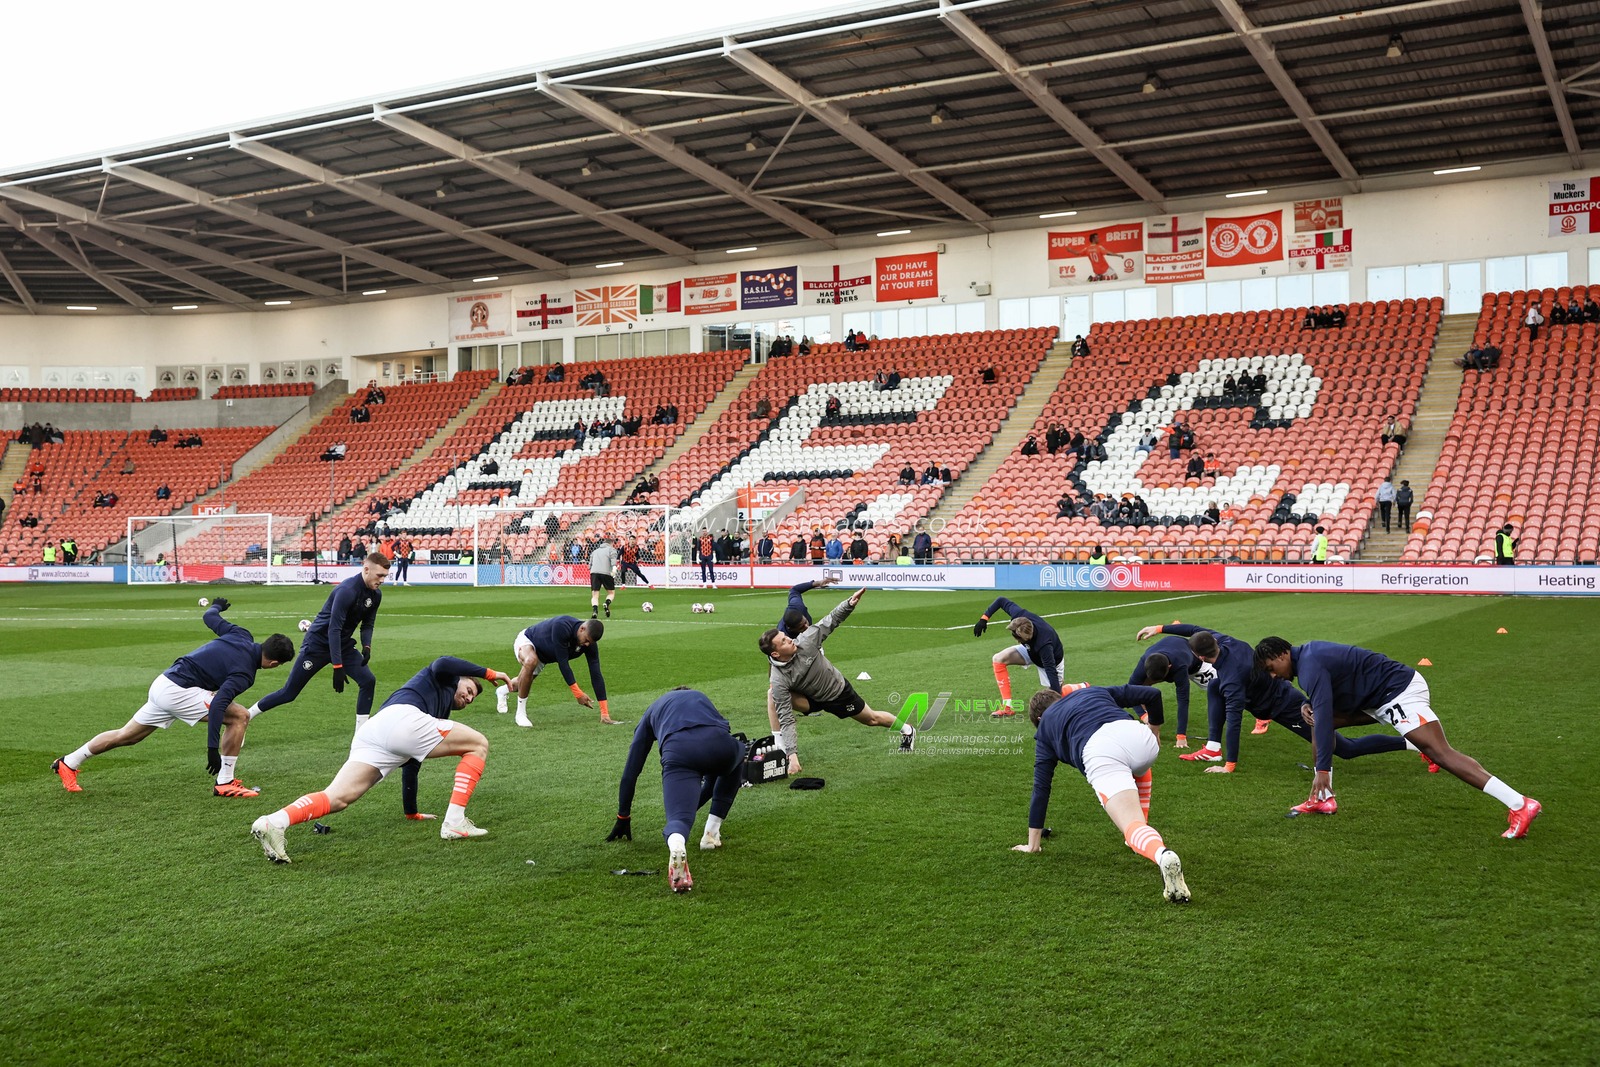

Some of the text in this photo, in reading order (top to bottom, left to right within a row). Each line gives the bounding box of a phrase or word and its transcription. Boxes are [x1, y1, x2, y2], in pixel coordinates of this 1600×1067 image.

[1554, 190, 1585, 200] Muckers
[1052, 230, 1139, 247] SUPER BRETT
[1290, 246, 1336, 257] BLACKPOOL
[906, 261, 927, 269] HAVE
[1059, 265, 1076, 274] FY6
[880, 270, 933, 281] OUR DREAMS
[820, 289, 855, 298] HACKNEY
[816, 295, 858, 304] SEASIDERS
[243, 570, 279, 580] Conditiong
[297, 571, 337, 579] Refrigration
[430, 571, 467, 579] Ventilation
[505, 565, 575, 584] ALLCOOL
[849, 572, 946, 582] www.allcoolnw.co.uk
[1040, 566, 1143, 588] ALLCOOL
[1246, 573, 1343, 586] Air Conditioning
[1381, 573, 1469, 587] Refrigeration
[1538, 574, 1595, 589] Heating
[1385, 703, 1407, 726] 27
